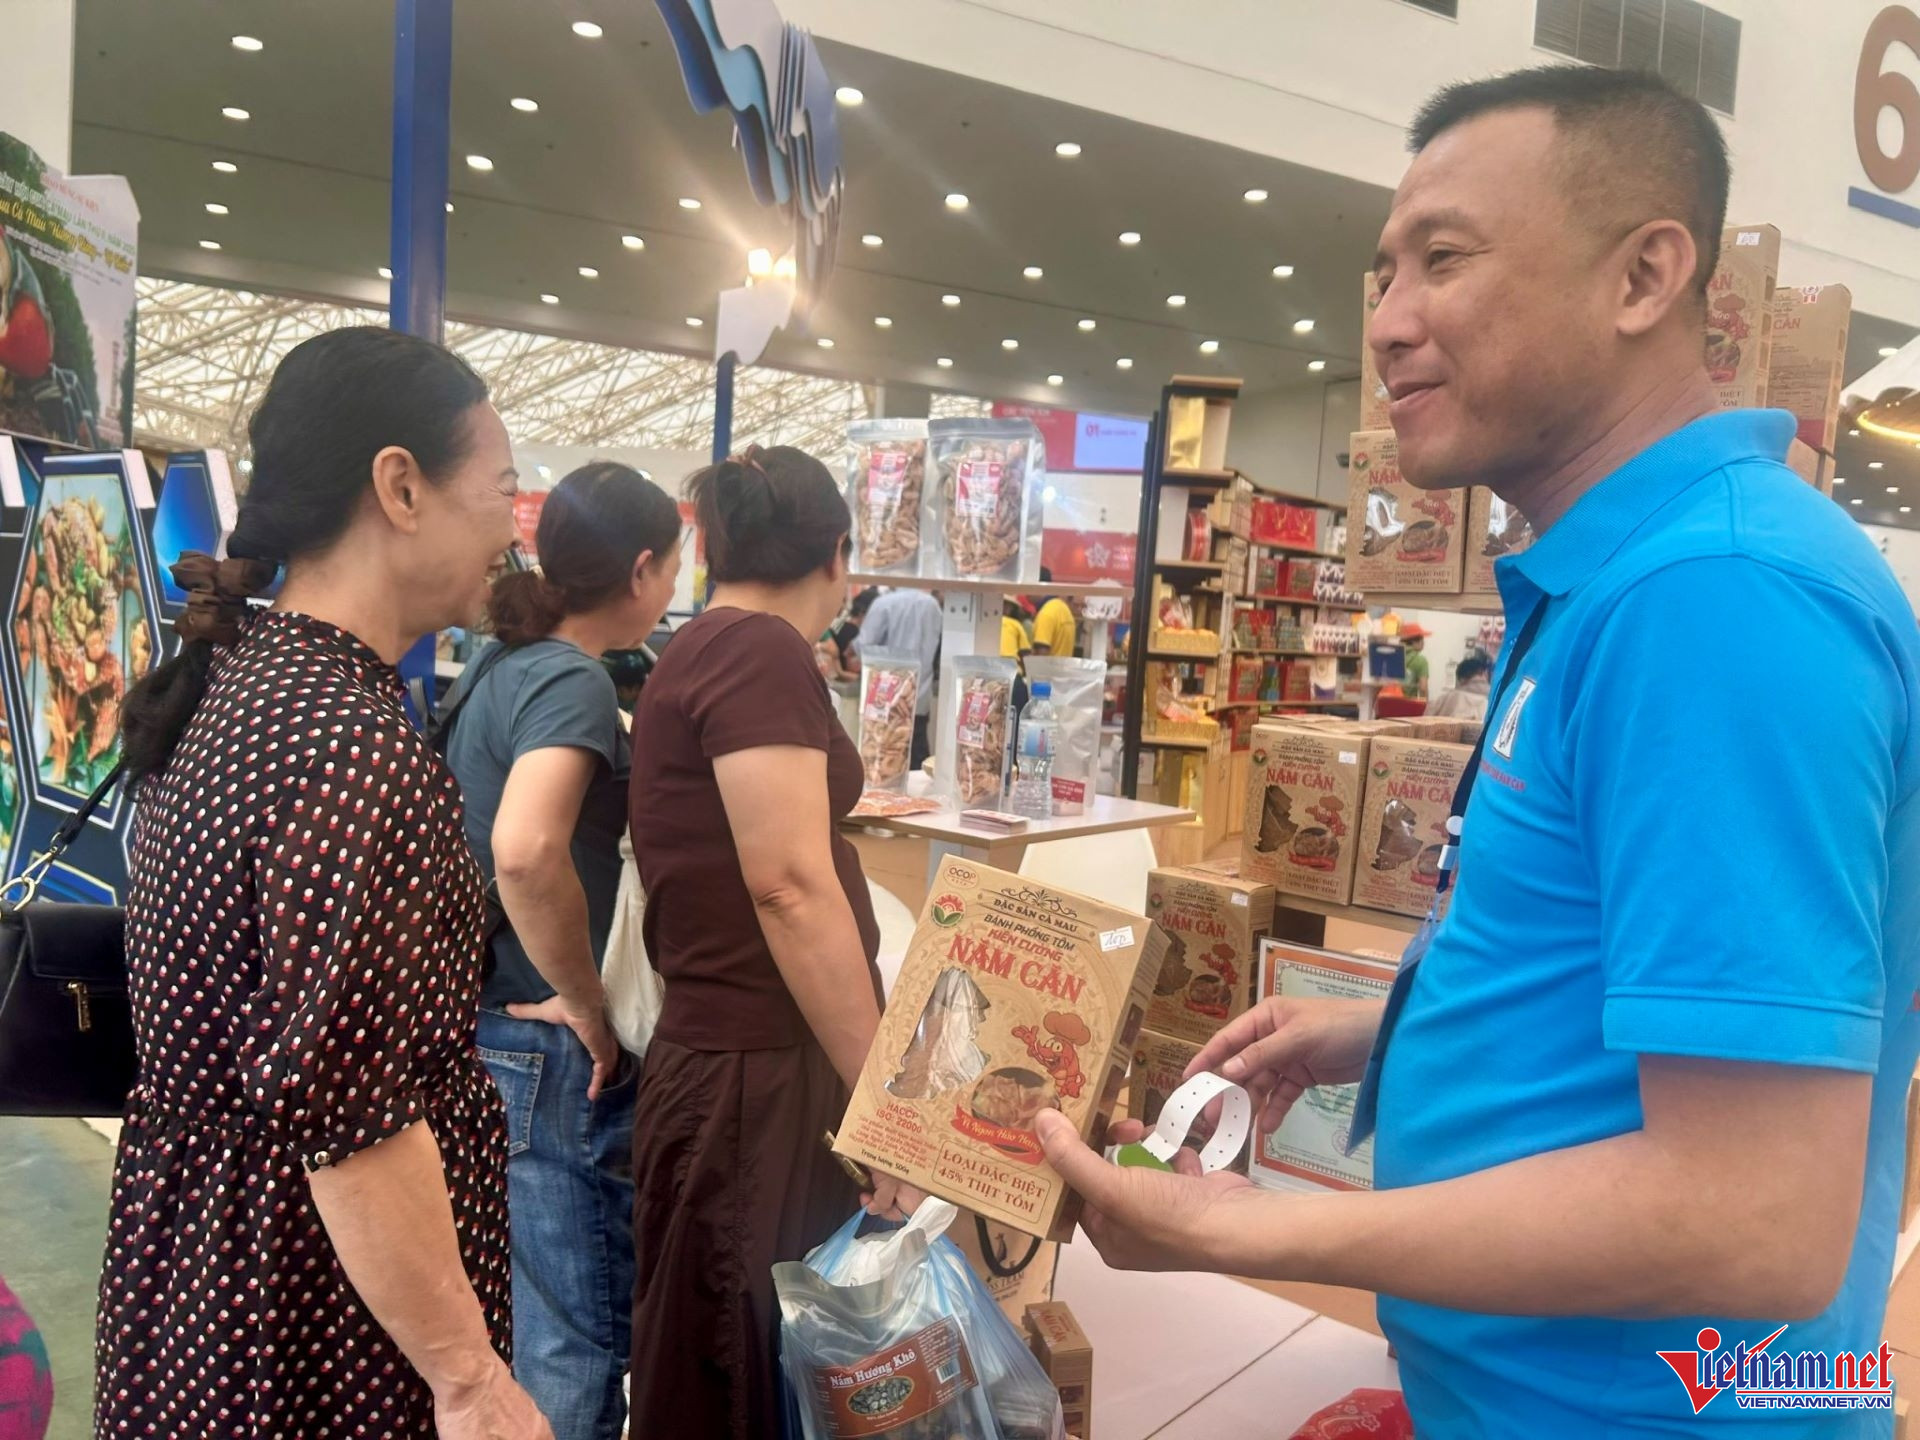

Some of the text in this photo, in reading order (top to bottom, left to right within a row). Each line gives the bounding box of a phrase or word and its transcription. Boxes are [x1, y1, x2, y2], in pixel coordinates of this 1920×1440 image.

[1854, 5, 1920, 194] 6
[949, 867, 976, 881] OCOP
[984, 913, 1075, 951] BÁNH PHỒNG TÔM
[993, 899, 1078, 933] ĐẶC SẢN CÀ MAU
[988, 928, 1018, 946] KIÊN
[946, 932, 1017, 981] NĂM
[1019, 960, 1087, 1004] CĂN
[886, 1101, 919, 1119] HACCP
[895, 1116, 922, 1134] 22000
[938, 1167, 1035, 1213] 45% THỊT TÔM
[942, 1149, 1045, 1199] LOẠI ĐẶC BIỆT
[830, 1348, 916, 1387] Nấm Hương Khô
